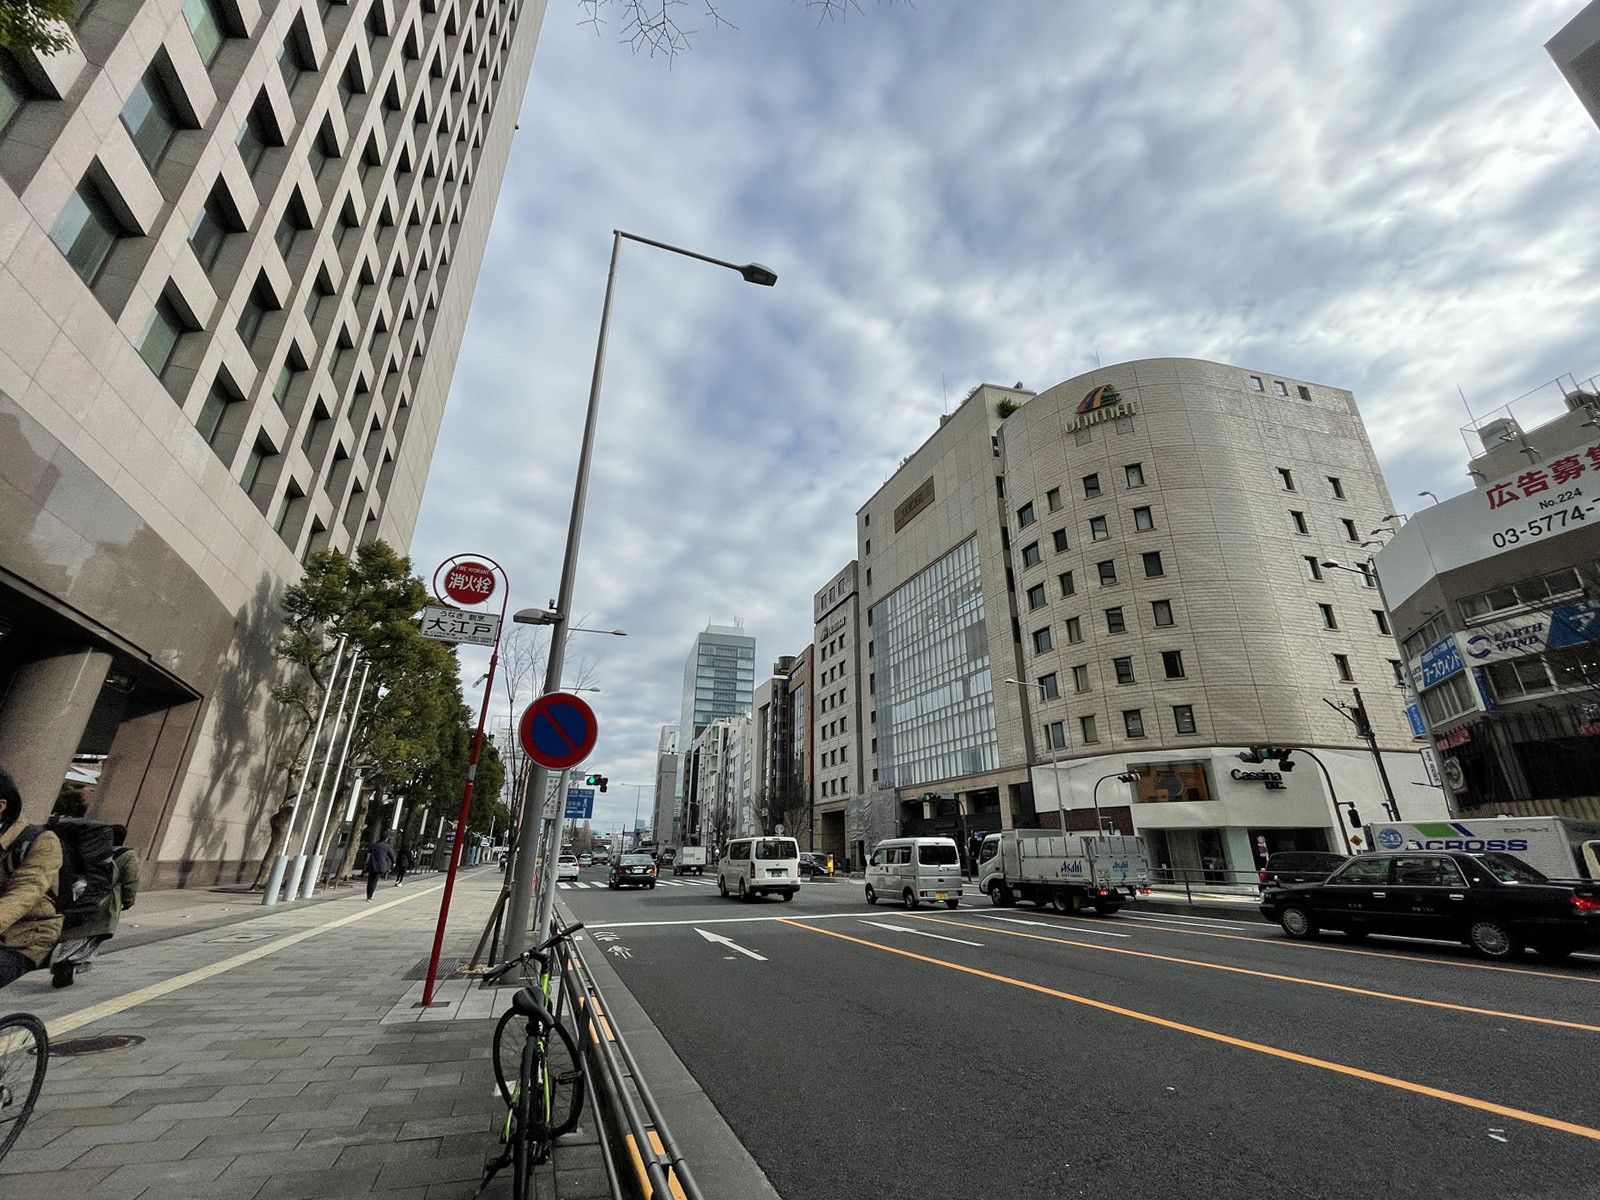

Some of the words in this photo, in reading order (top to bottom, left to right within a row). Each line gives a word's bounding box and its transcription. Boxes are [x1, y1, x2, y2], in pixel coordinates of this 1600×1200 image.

[1539, 487, 1582, 509] No.224
[448, 572, 492, 594] 消火栓
[440, 610, 463, 619] うなぎ
[426, 617, 493, 636] 大江戸
[1493, 622, 1544, 641] EARTH
[1496, 635, 1540, 651] WIND
[1230, 768, 1283, 781] Cassina
[1061, 860, 1083, 873] Asahi
